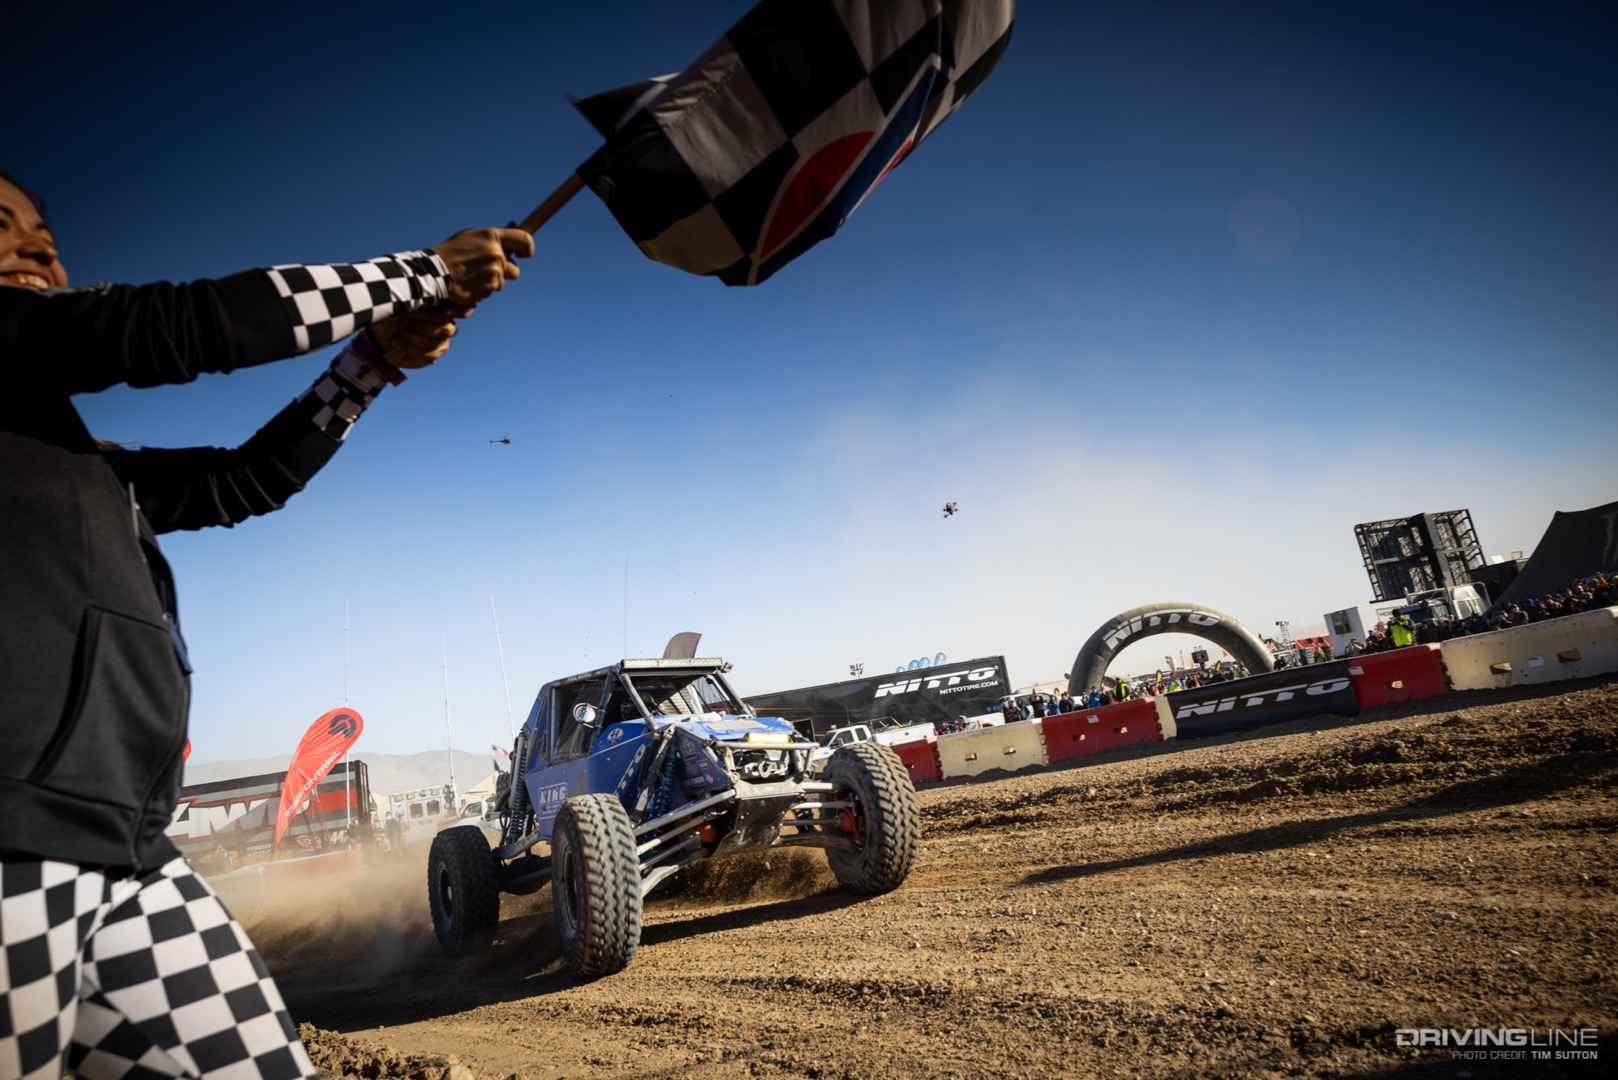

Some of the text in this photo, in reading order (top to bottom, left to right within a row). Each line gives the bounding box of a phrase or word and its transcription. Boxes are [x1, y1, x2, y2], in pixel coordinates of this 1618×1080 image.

[1102, 609, 1220, 650] NITTO
[874, 666, 997, 698] NITTO
[939, 680, 999, 695] NITTOTIRE.COM
[1175, 677, 1350, 719] NITTO
[303, 750, 342, 791] ONTRAIL
[540, 786, 566, 804] KING
[246, 843, 273, 853] POISO
